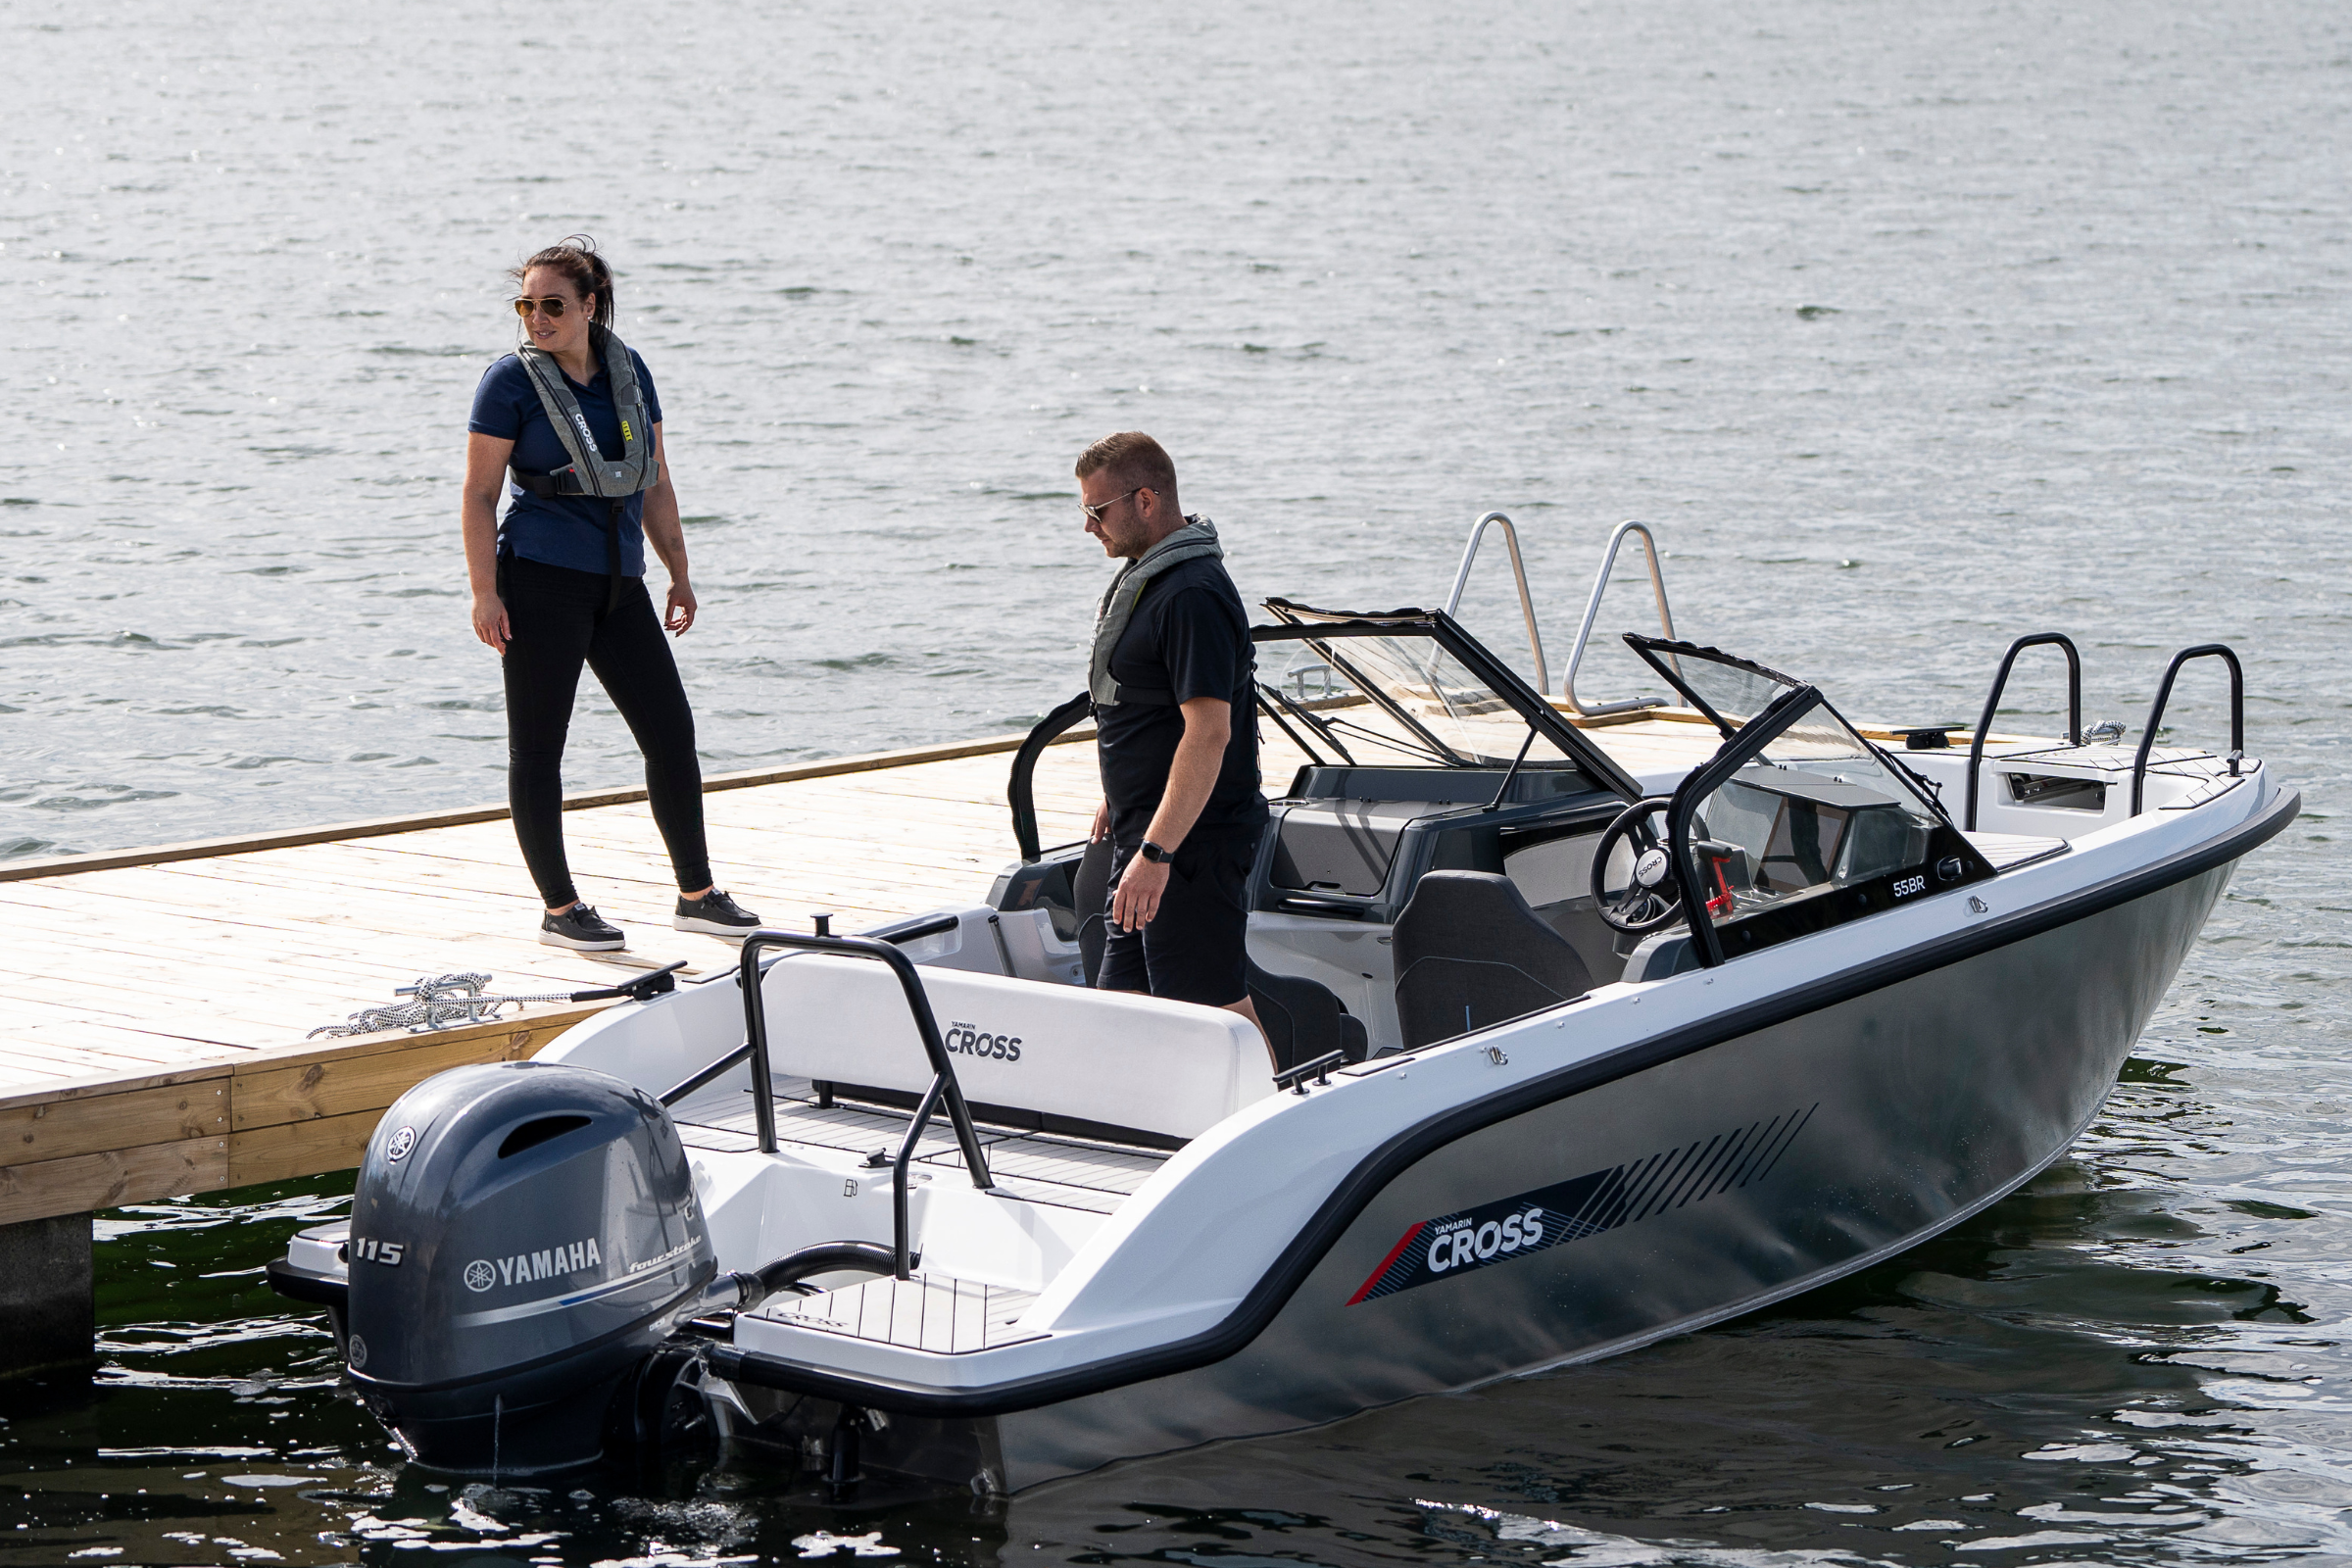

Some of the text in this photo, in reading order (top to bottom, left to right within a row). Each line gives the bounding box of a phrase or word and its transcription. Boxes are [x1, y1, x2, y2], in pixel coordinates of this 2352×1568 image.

[575, 413, 598, 452] CROSS
[1639, 856, 1663, 878] CROSS
[1892, 875, 1926, 898] 55BR
[951, 1020, 976, 1030] YAMARIN
[945, 1028, 1022, 1062] CROSS
[1427, 1207, 1544, 1273] CROSS
[1434, 1217, 1473, 1236] YAMARIN
[357, 1237, 404, 1266] 115
[496, 1237, 602, 1286] YAMAHA
